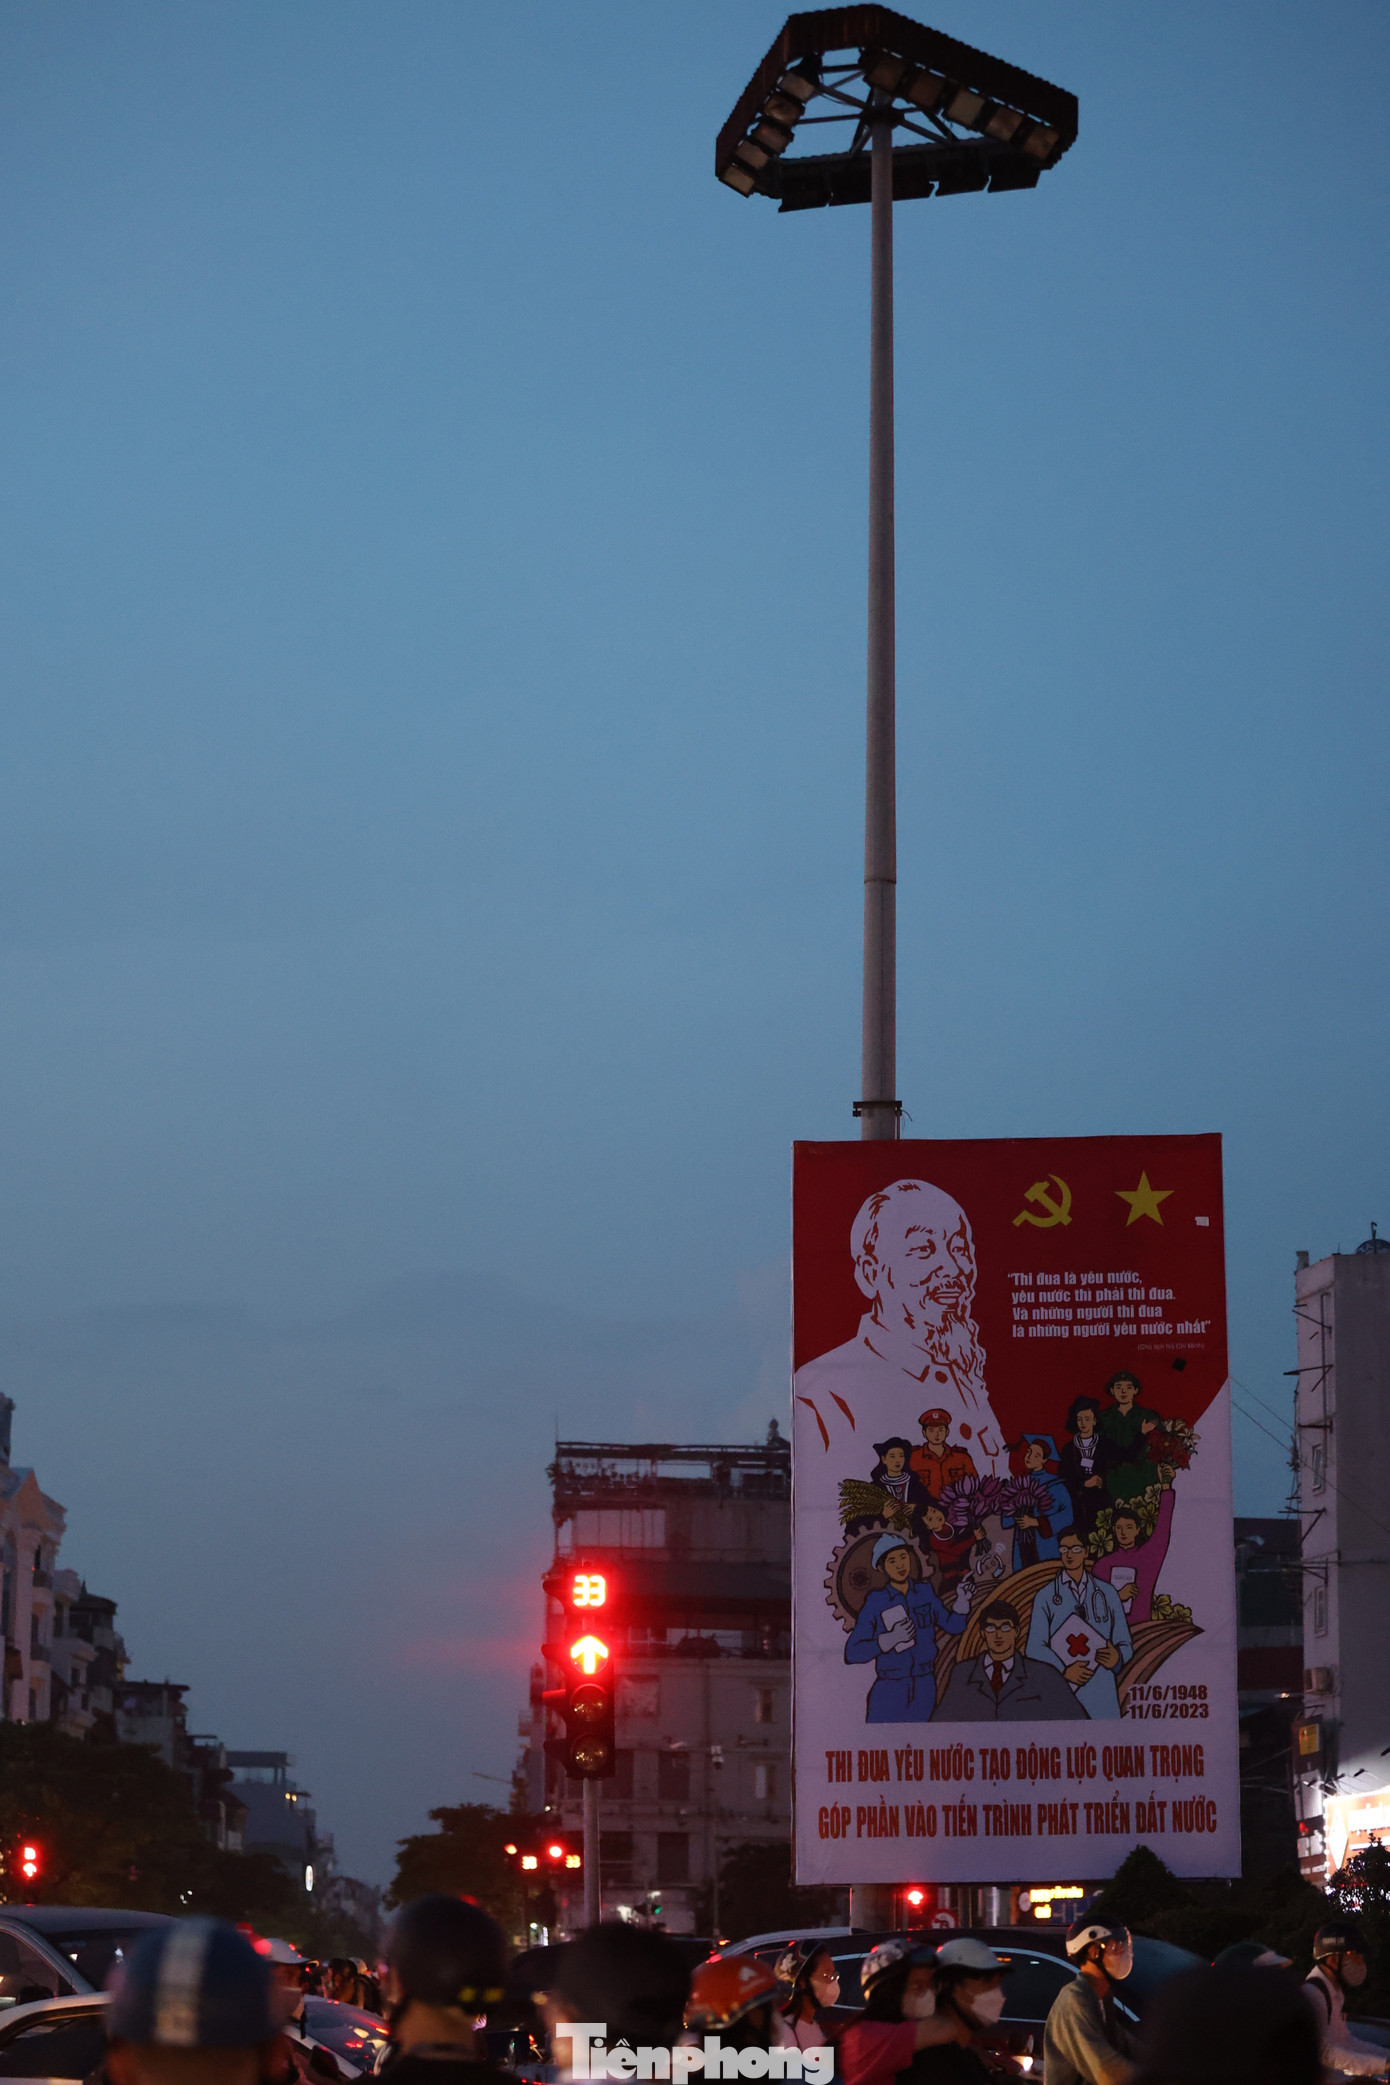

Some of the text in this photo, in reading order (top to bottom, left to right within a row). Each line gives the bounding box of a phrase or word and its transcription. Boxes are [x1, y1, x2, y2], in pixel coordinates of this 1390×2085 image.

[1036, 1272, 1060, 1285] đua
[1064, 1272, 1076, 1285] là
[1081, 1271, 1103, 1286] yêu
[1108, 1270, 1142, 1284] nước,
[1012, 1287, 1175, 1304] yêu nước thì phải thi đua.
[1012, 1305, 1162, 1320] Và những người thi đua
[1012, 1324, 1024, 1337] là
[1028, 1324, 1069, 1338] những
[1073, 1323, 1110, 1337] người
[1114, 1322, 1136, 1337] yêu
[1141, 1321, 1172, 1334] nước
[573, 1575, 606, 1606] 33
[1130, 1685, 1207, 1701] 11/6/1948
[1129, 1703, 1208, 1719] 11/6/2023
[825, 1742, 1204, 1787] THI ĐUA YÊU NƯỚC TẠO ĐỘNG LỰC QUAN TRỌNG
[818, 1790, 1217, 1840] GÓP PHẦN VÀO TIẾN TRÌNH PHÁT TRIỂN ĐẤT NƯỚC
